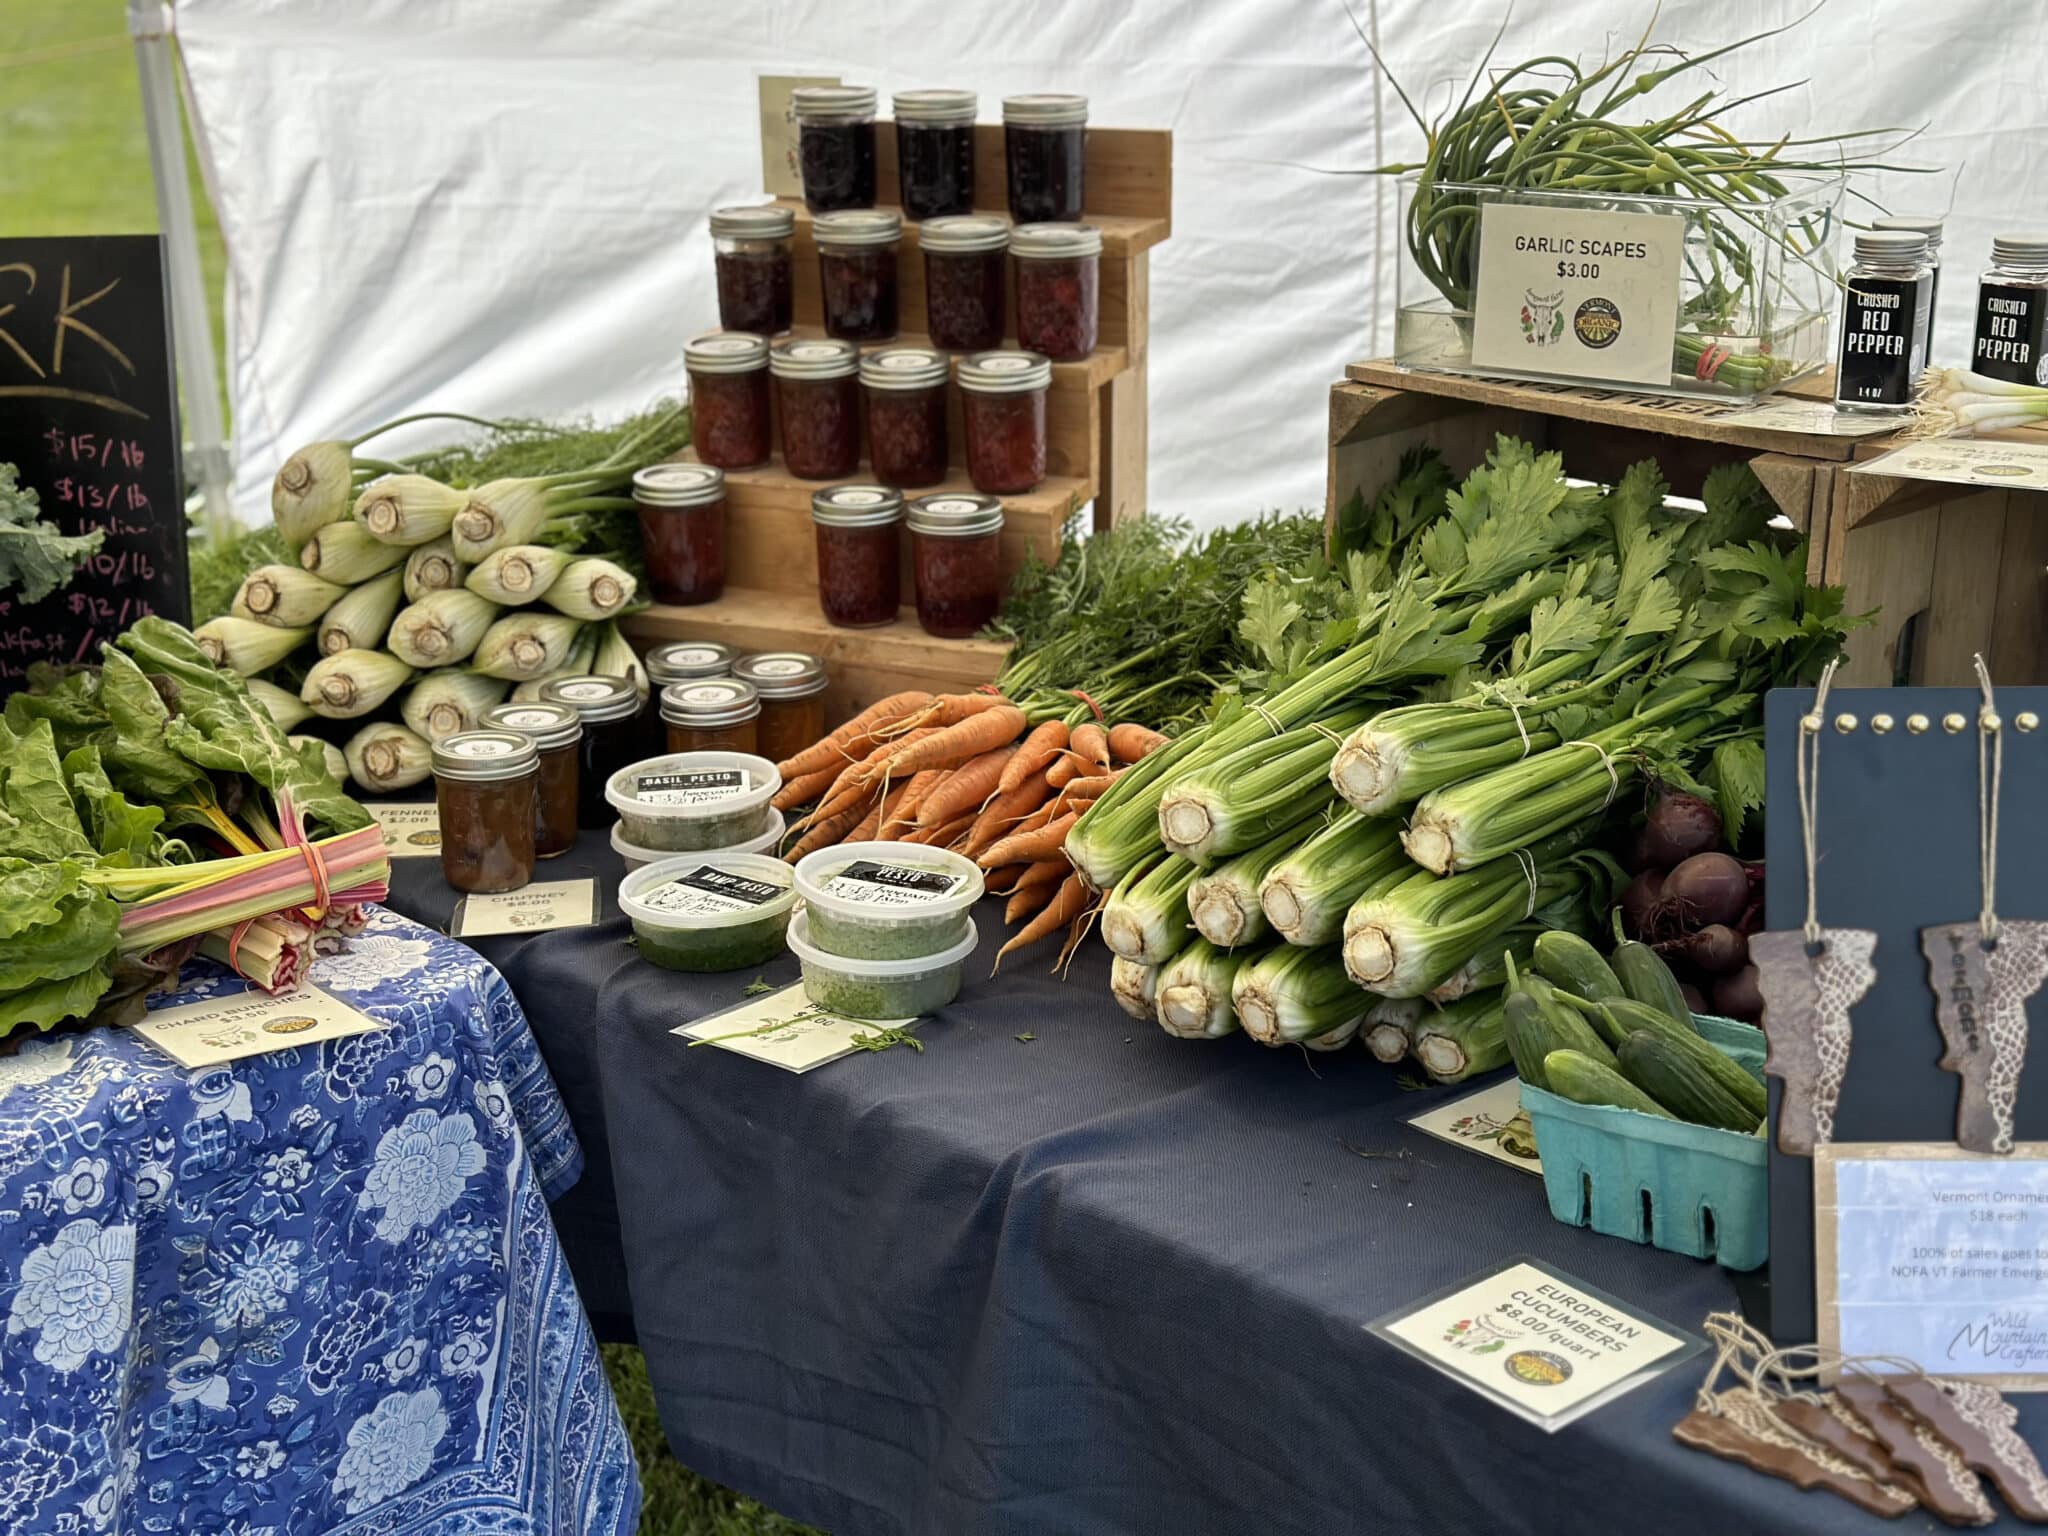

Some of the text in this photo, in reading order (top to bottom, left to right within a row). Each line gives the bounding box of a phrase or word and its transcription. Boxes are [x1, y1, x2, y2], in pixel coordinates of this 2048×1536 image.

[1515, 236, 1647, 259] GARLIC SCAPES
[1556, 261, 1600, 279] $3.00
[1857, 293, 1900, 309] CRUSHED
[1988, 297, 2027, 316] CRUSHED
[1862, 310, 1890, 331] RED
[1991, 316, 2017, 338] RED
[1848, 332, 1904, 356] PEPPER
[1978, 337, 2030, 364] PEPPER
[74, 552, 155, 586] 10/lb
[645, 773, 731, 785] BASIL PESTO
[701, 872, 737, 885] RAMP
[734, 880, 776, 896] PESTO
[875, 869, 923, 882] PESTO
[491, 892, 568, 902] CHUTNEY
[155, 993, 311, 1030] CHARD BUNCHES
[1933, 1192, 2048, 1203] Vermont Orname
[1970, 1209, 2028, 1222] $18 each
[1912, 1247, 1947, 1259] 100%
[1951, 1247, 1962, 1259] of
[1967, 1248, 1998, 1259] sales
[2002, 1249, 2032, 1262] goes
[1891, 1266, 1928, 1278] NOFA
[1932, 1266, 1947, 1277] VT
[1952, 1266, 1998, 1278] Farmer
[1535, 1283, 1641, 1340] EUROPEAN
[1987, 1311, 2029, 1329] Wild
[1495, 1303, 1601, 1361] $8.00/quart
[1510, 1290, 1629, 1354] CUCUMBERS
